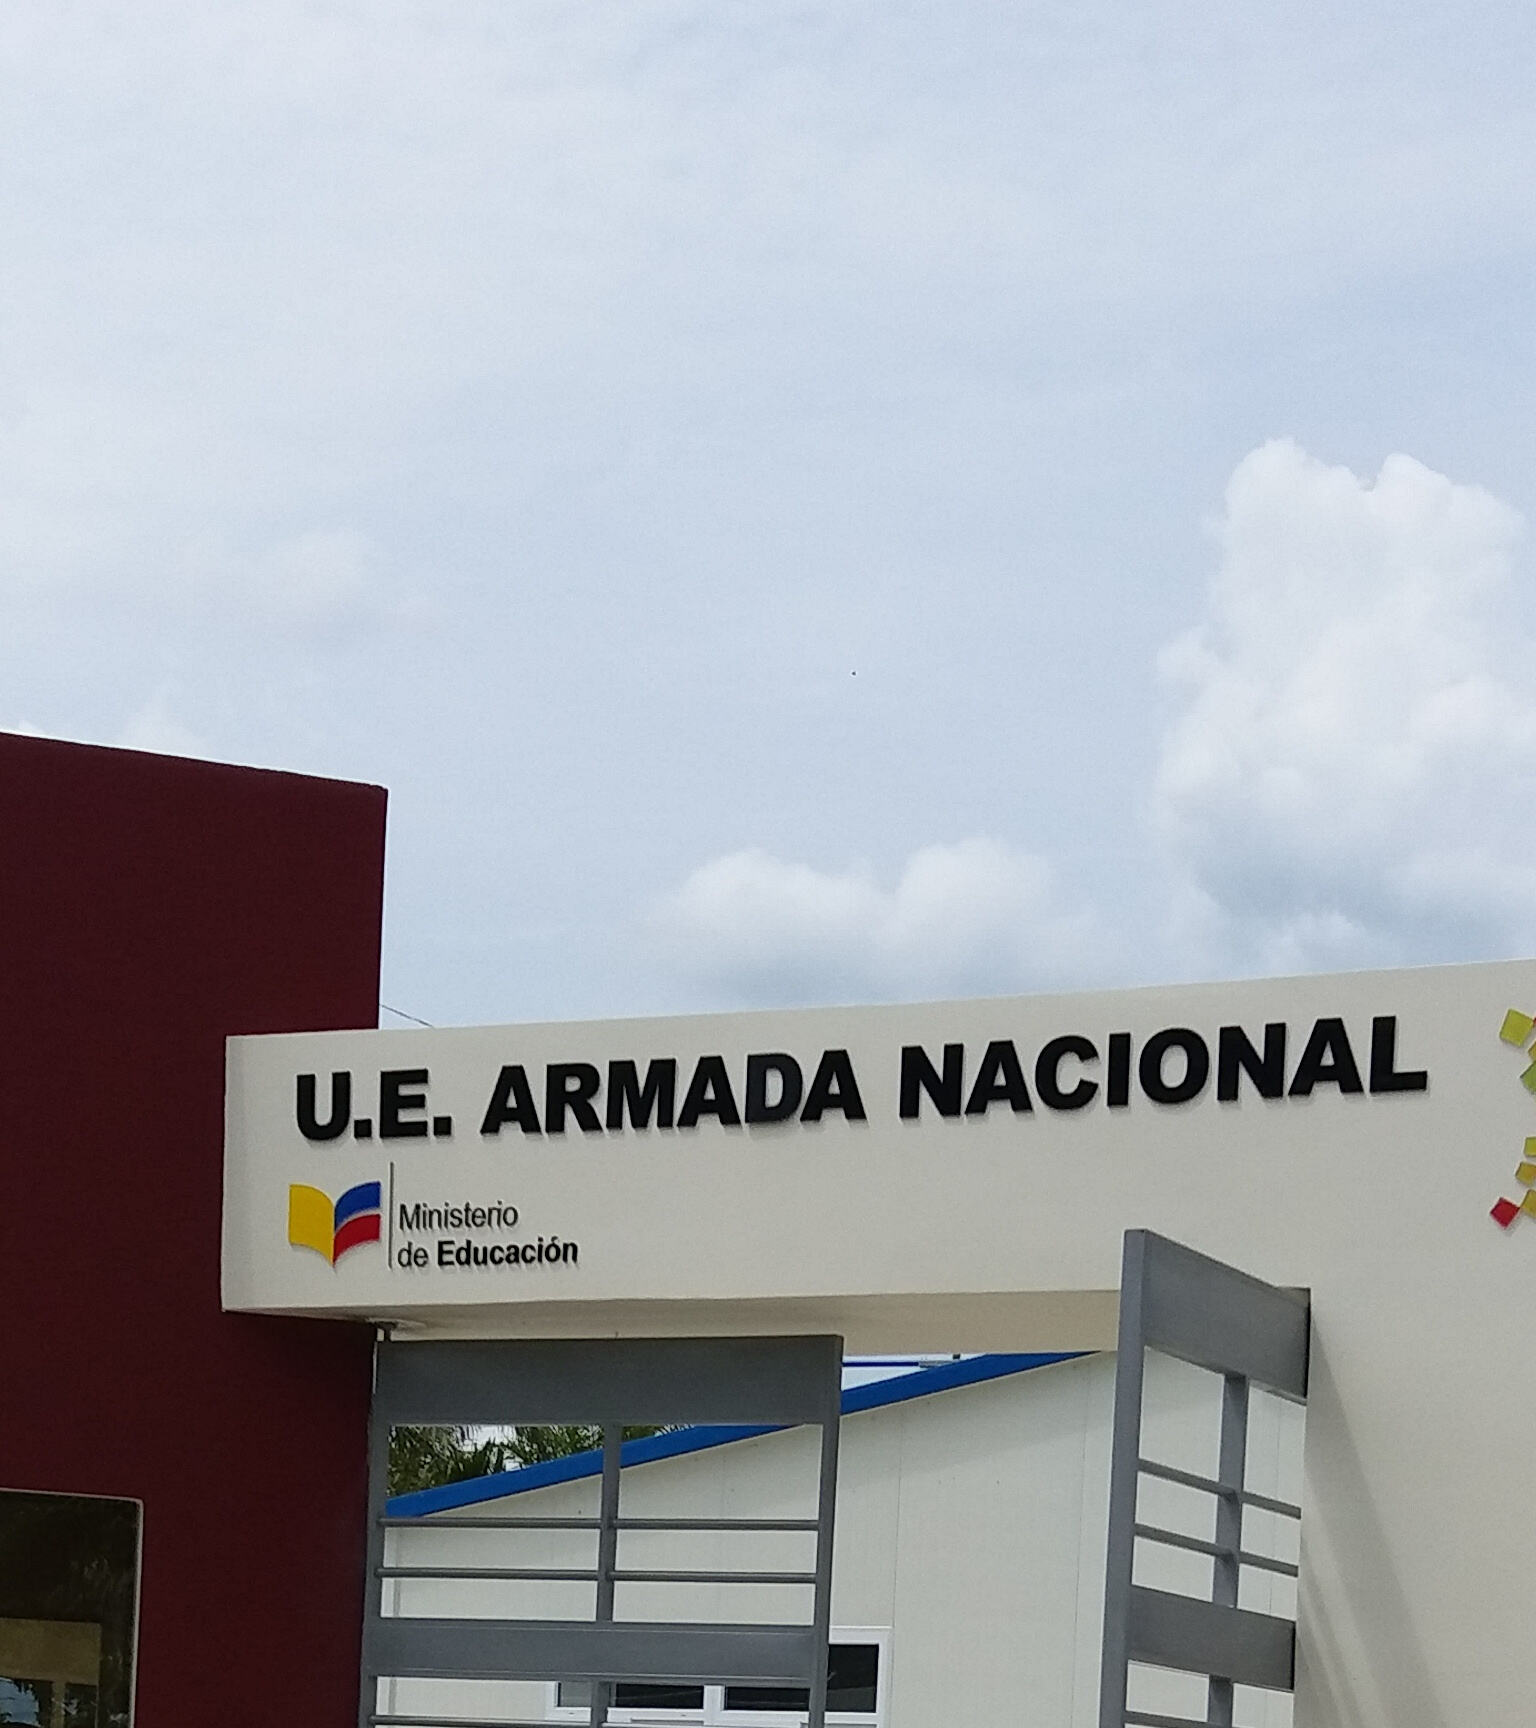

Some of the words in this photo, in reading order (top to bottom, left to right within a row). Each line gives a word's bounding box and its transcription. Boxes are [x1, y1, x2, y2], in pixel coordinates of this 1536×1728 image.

[296, 1068, 452, 1143] U.E.
[479, 1049, 868, 1136] ARMADA
[899, 1015, 1428, 1120] NACIONAL
[399, 1200, 519, 1233] Ministerio
[397, 1240, 429, 1269] de
[437, 1235, 579, 1268] Educación
